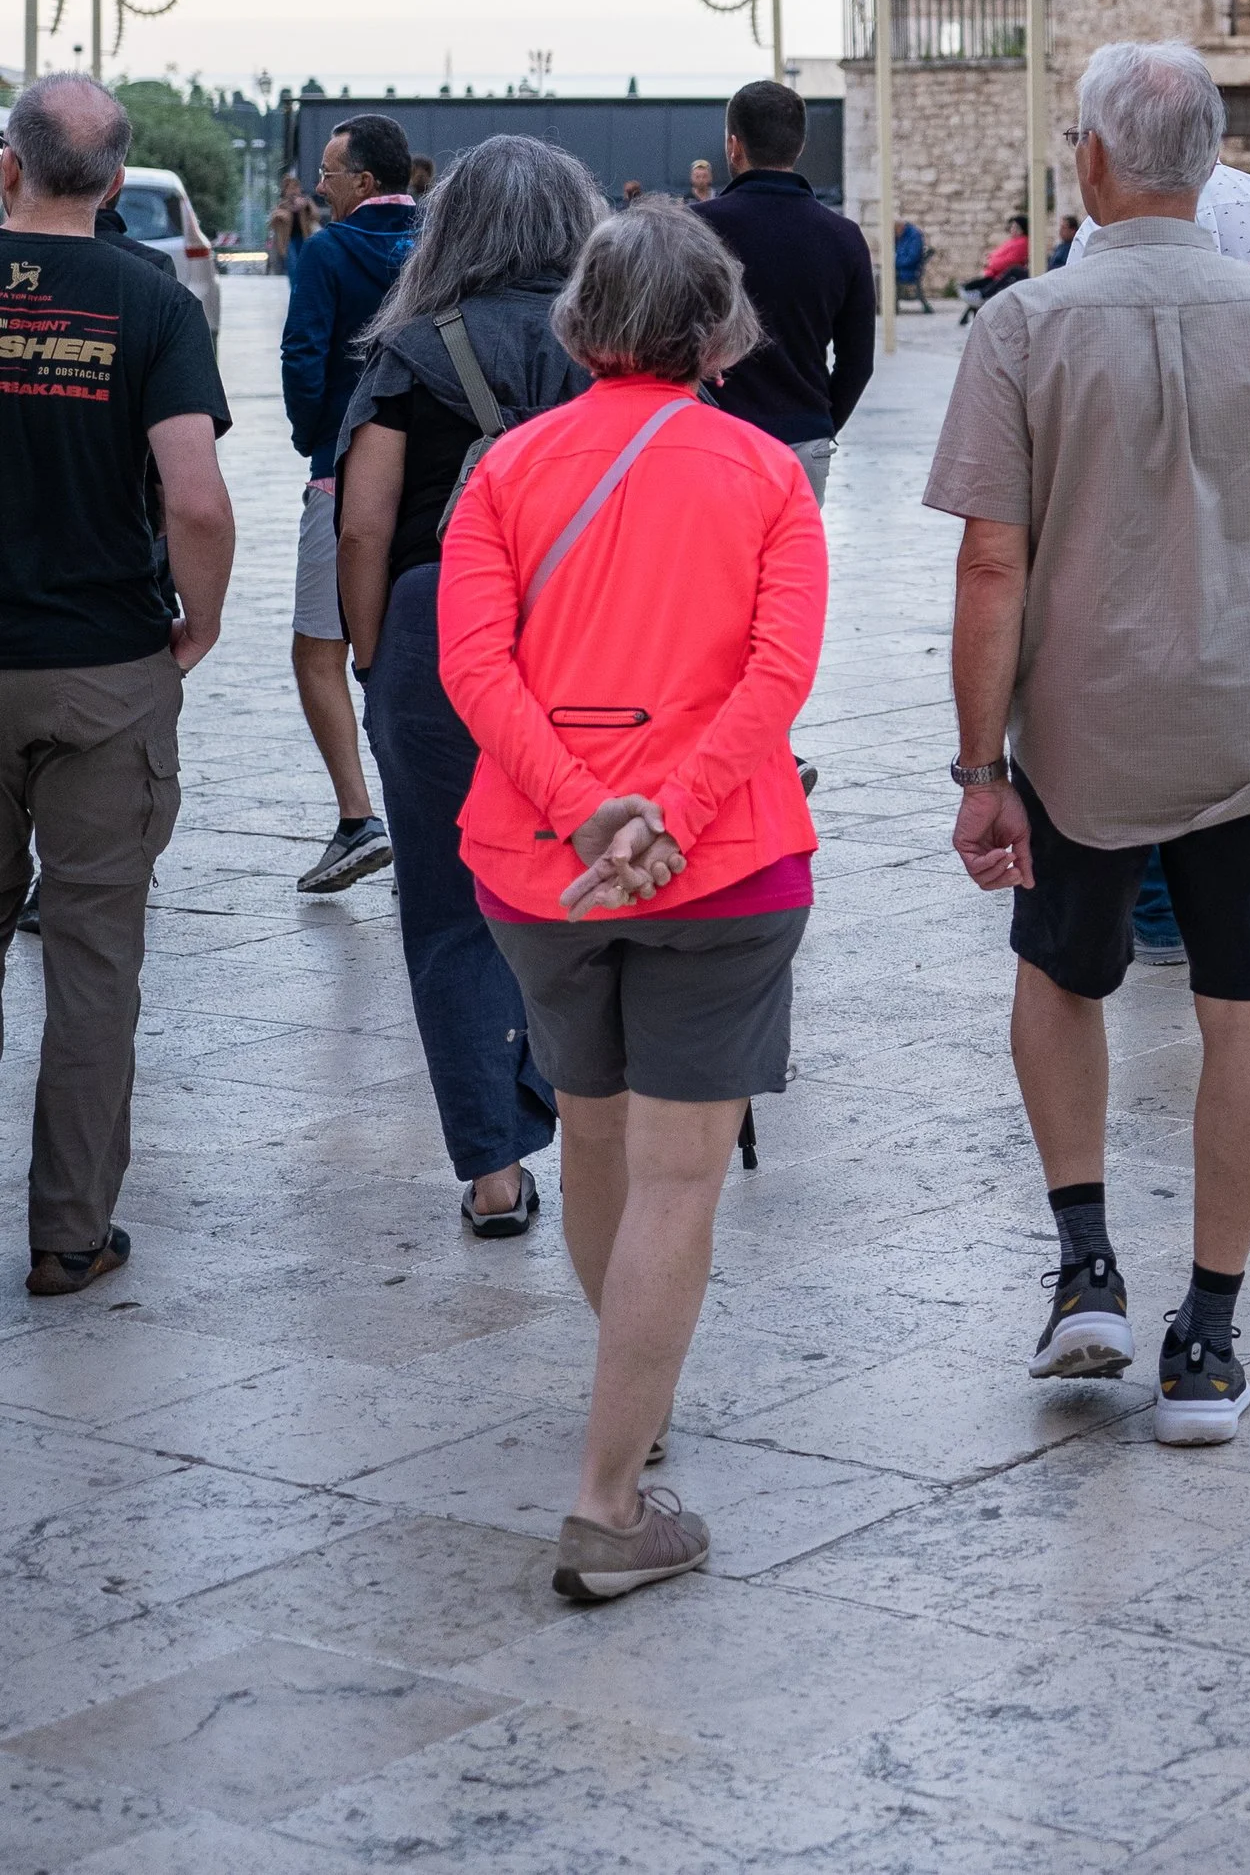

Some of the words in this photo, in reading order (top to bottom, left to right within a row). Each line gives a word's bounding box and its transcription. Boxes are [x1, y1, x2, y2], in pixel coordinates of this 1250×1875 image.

[9, 319, 71, 332] SPRINT
[0, 335, 116, 365] SHER
[38, 367, 49, 375] 20
[55, 367, 111, 382] OBSTACLES
